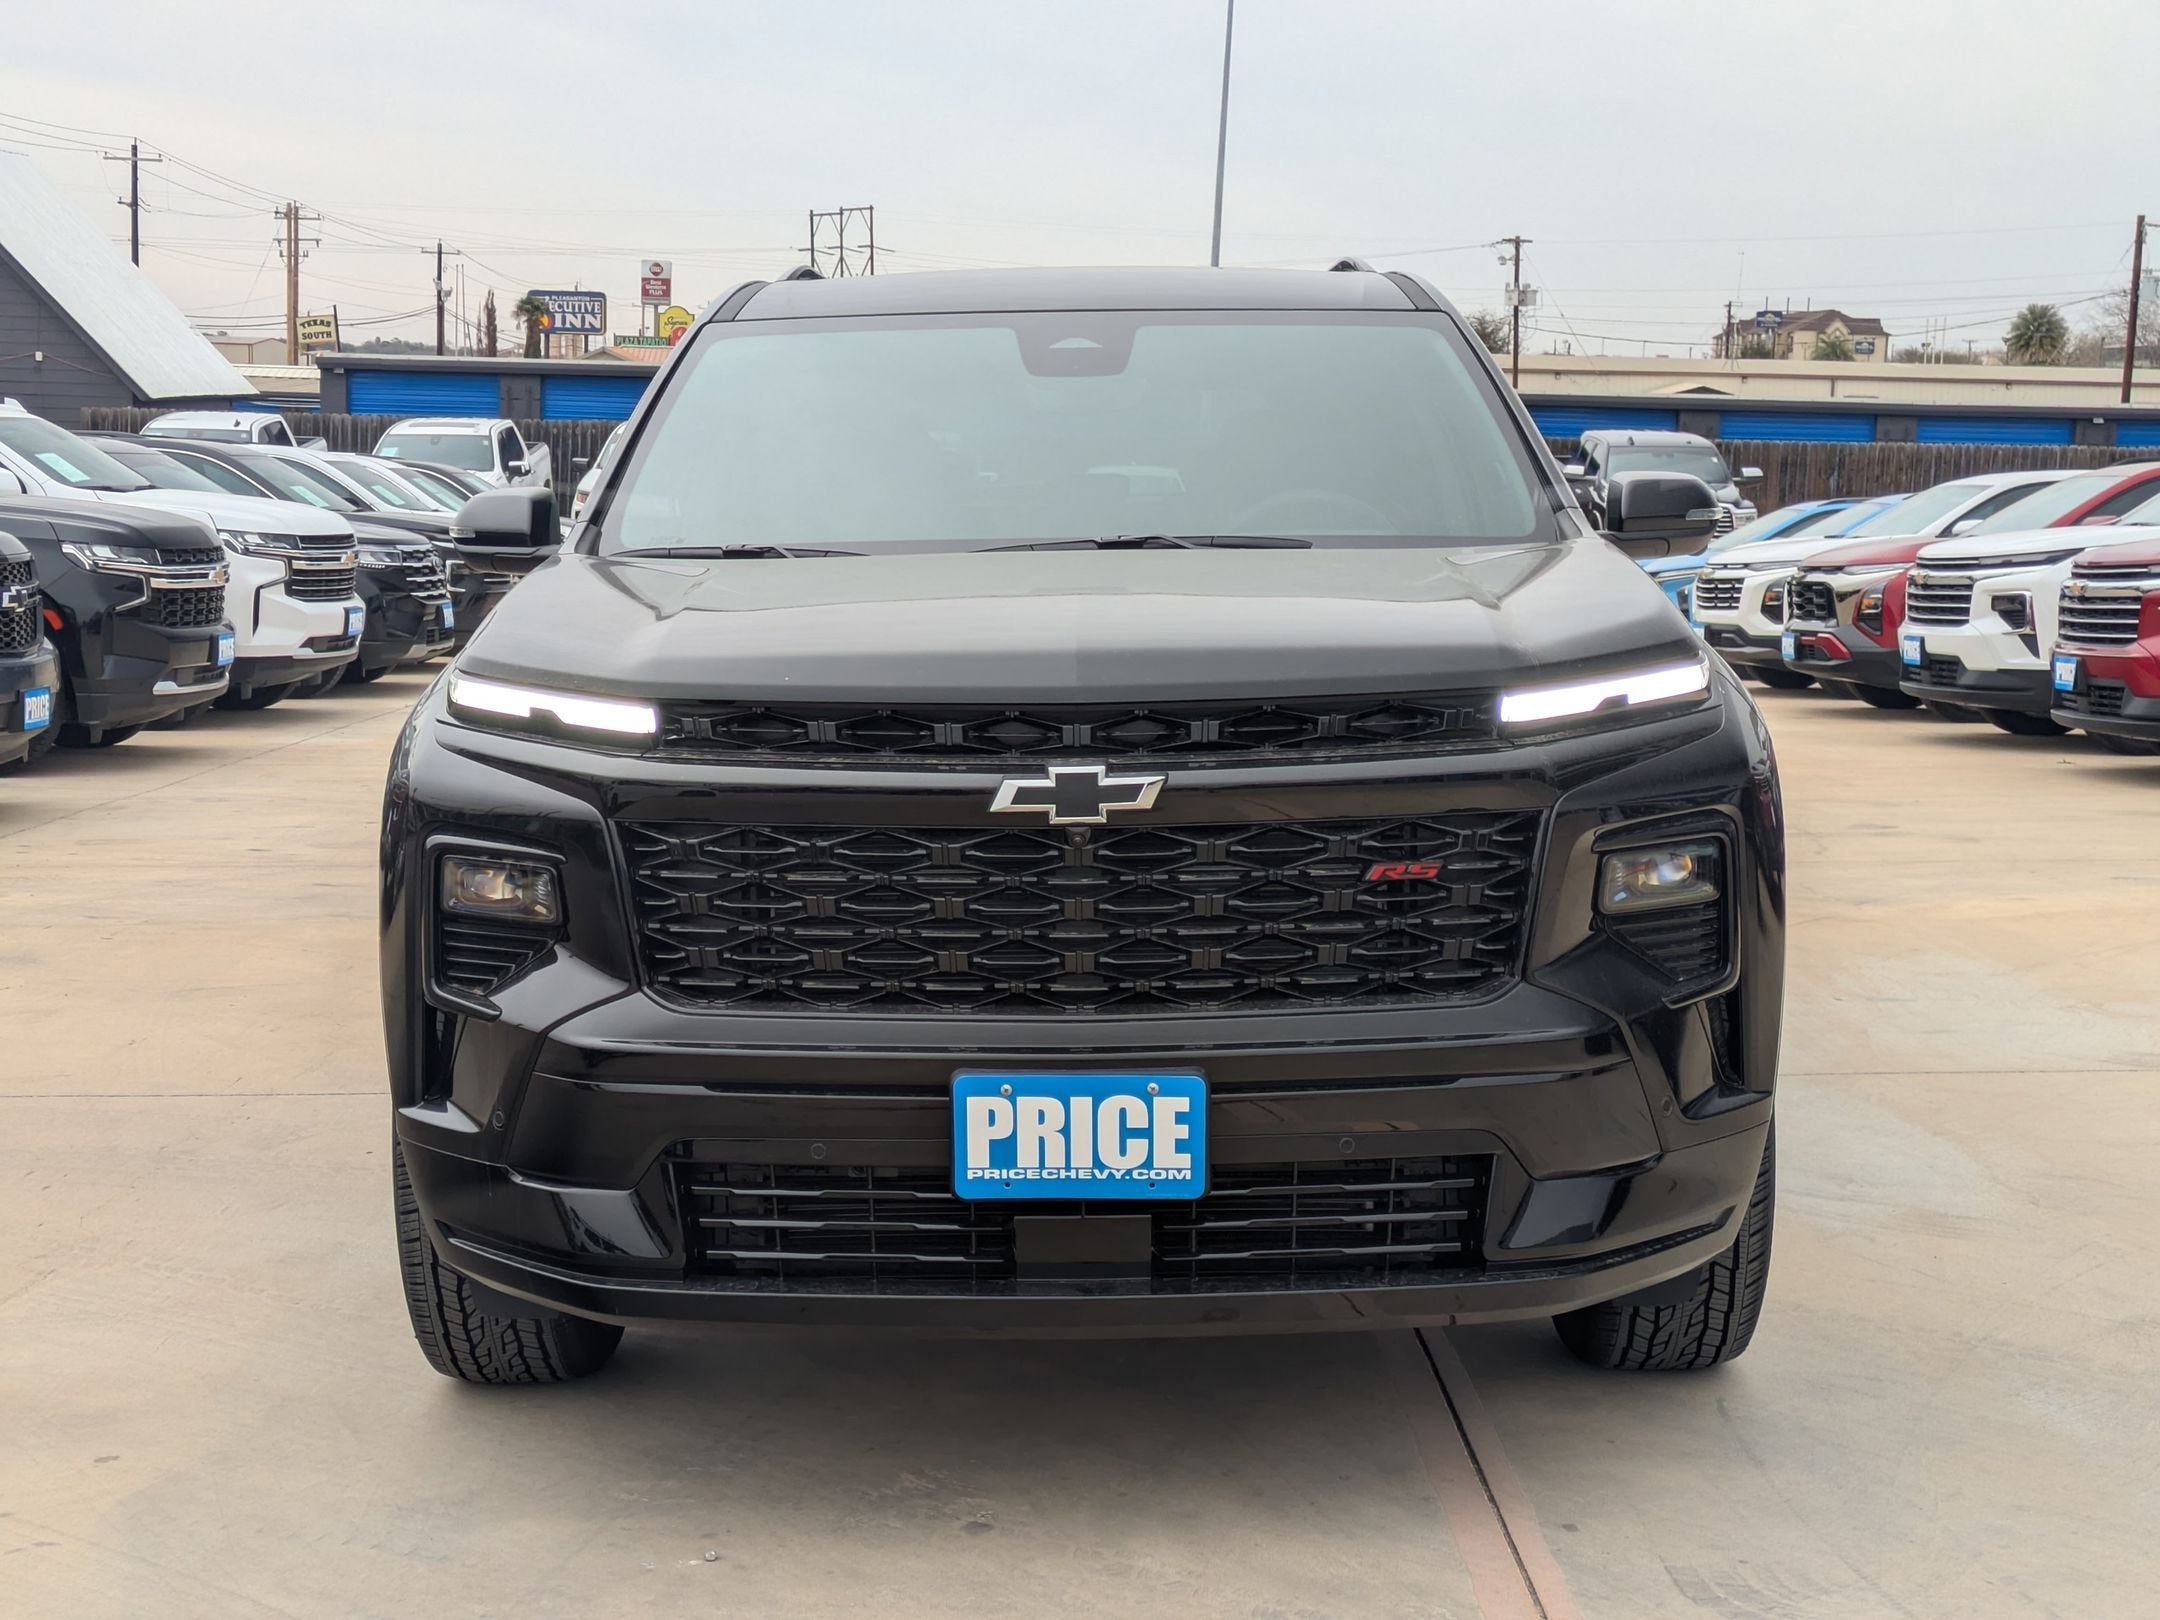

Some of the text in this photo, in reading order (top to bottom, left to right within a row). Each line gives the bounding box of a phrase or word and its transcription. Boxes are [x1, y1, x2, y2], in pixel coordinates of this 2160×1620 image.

[299, 319, 332, 329] TEXAS
[553, 313, 602, 328] INN
[301, 331, 332, 340] SOUTH
[616, 336, 667, 346] PLAZA TAPATIO
[25, 694, 49, 720] PRICE
[1366, 861, 1443, 881] RS
[966, 1095, 1192, 1169] PRICE
[967, 1169, 1192, 1180] PRICECHEVY.COM
